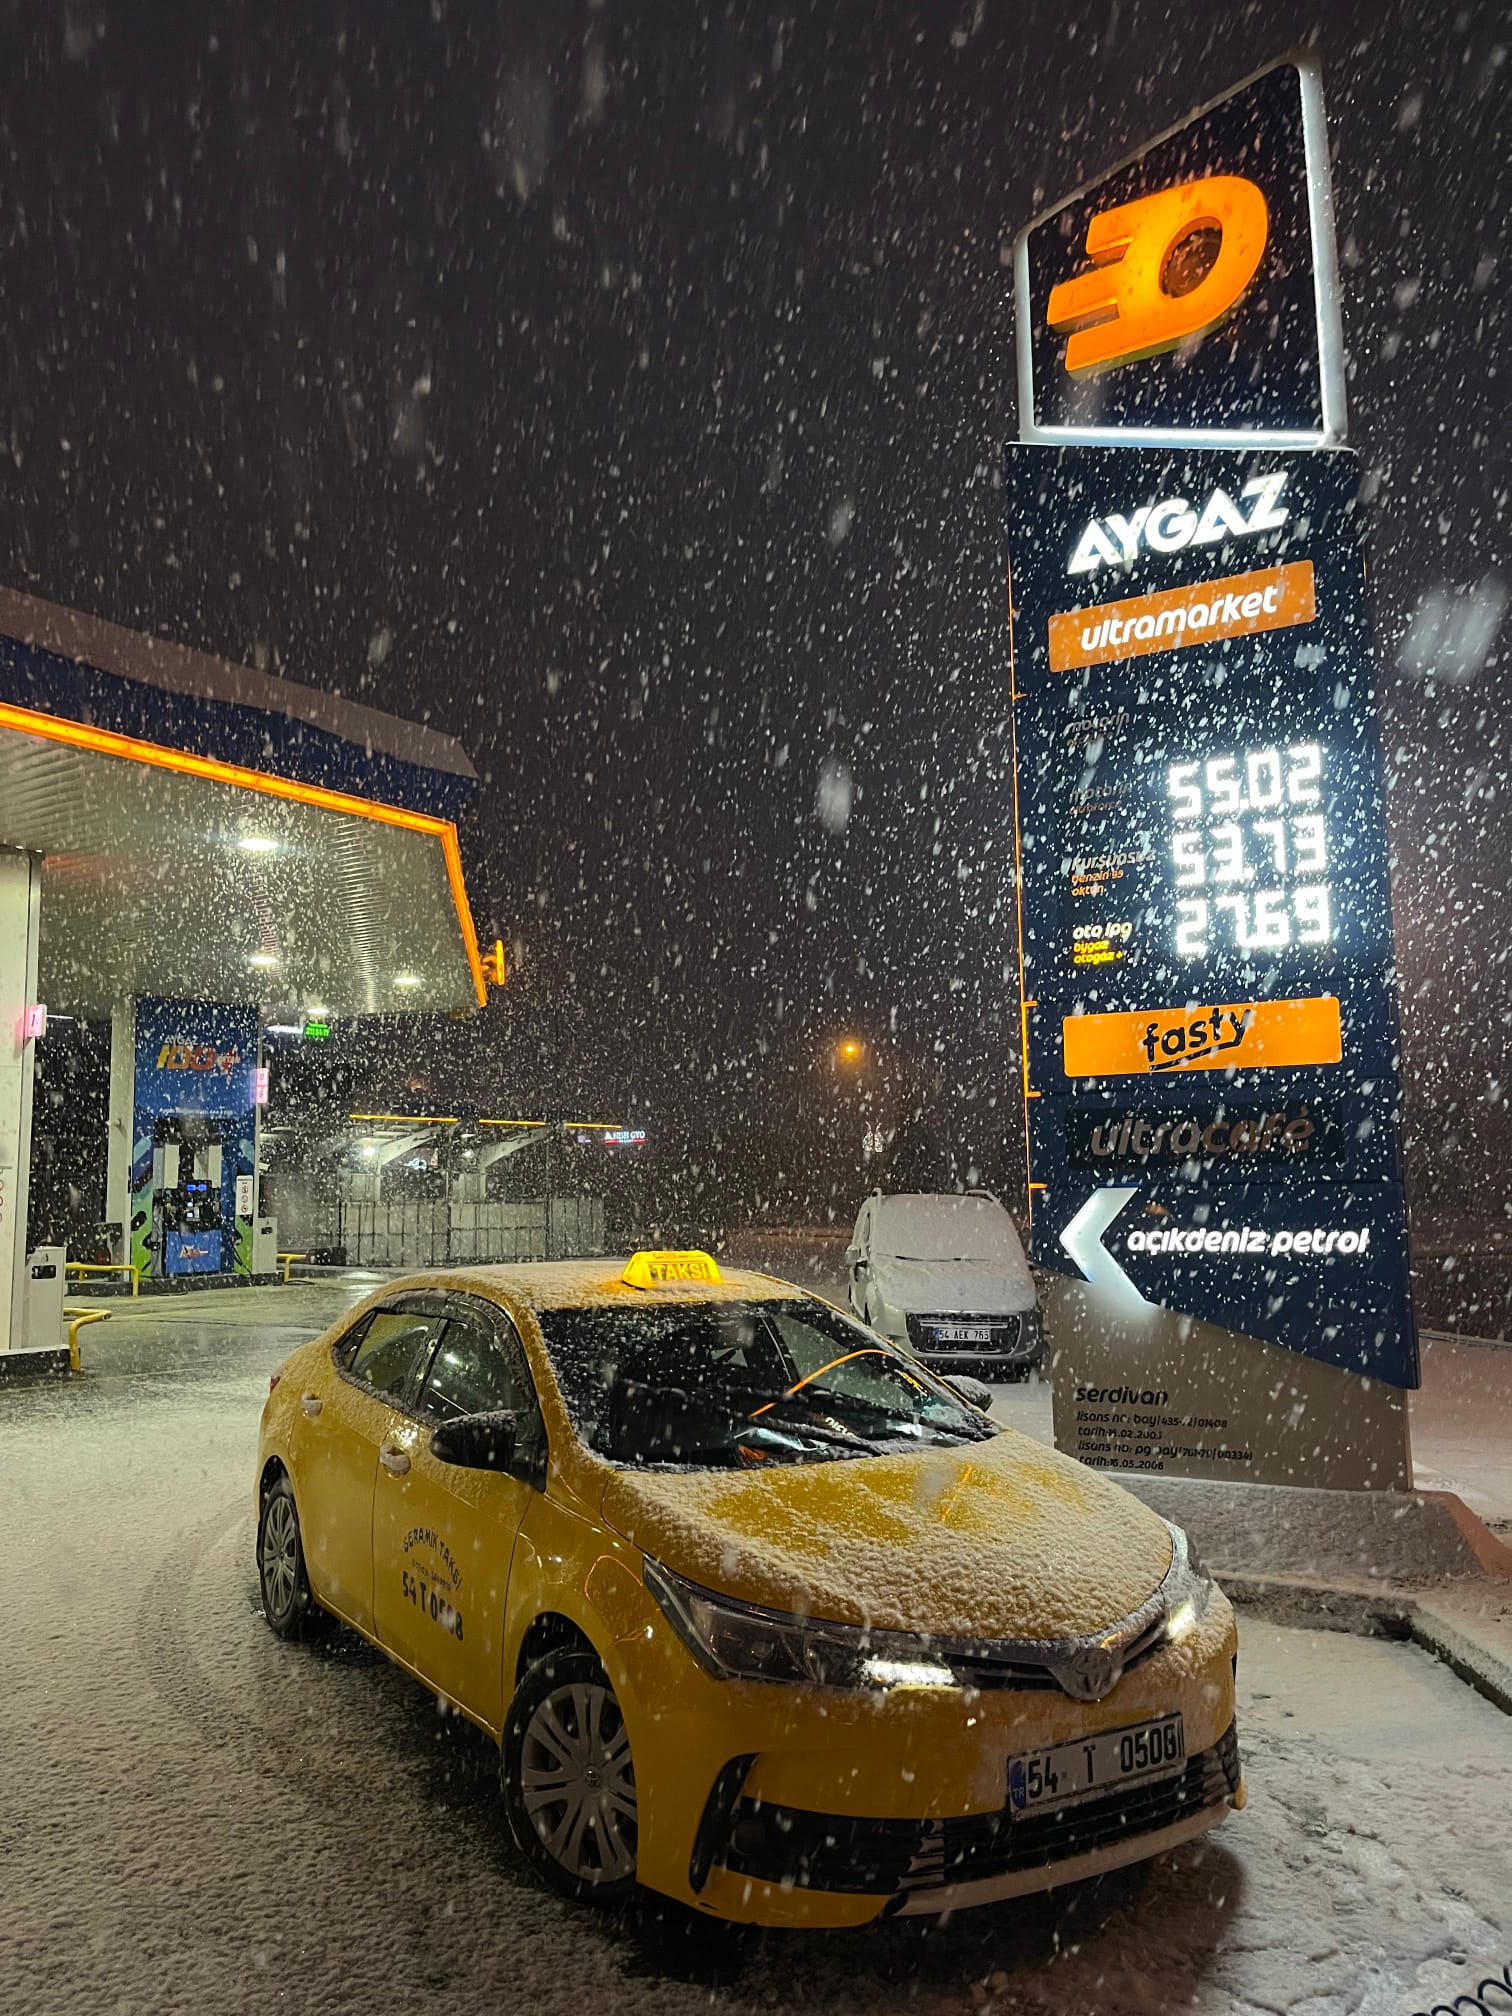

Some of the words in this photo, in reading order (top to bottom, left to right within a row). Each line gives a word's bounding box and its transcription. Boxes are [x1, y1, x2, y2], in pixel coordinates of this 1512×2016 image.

[1067, 471, 1289, 575] AYGAZ
[1080, 585, 1278, 651] ultramarket
[1168, 743, 1322, 820] 55.02
[1172, 813, 1327, 888] 53.73
[1072, 925, 1102, 939] oto
[1105, 922, 1132, 943] lpg
[1175, 884, 1331, 957] 27.69
[1073, 940, 1110, 953] aygaz
[1143, 1008, 1251, 1070] fasty
[1090, 1105, 1314, 1156] ultracafé
[1271, 1228, 1370, 1253] petrol
[938, 1330, 949, 1340] 54
[1076, 1386, 1169, 1405] serdivan
[1077, 1410, 1110, 1423] lisans
[1078, 1440, 1111, 1452] lisans
[1013, 1786, 1025, 1799] TR
[1027, 1756, 1059, 1799] 54
[1083, 1744, 1096, 1784] T
